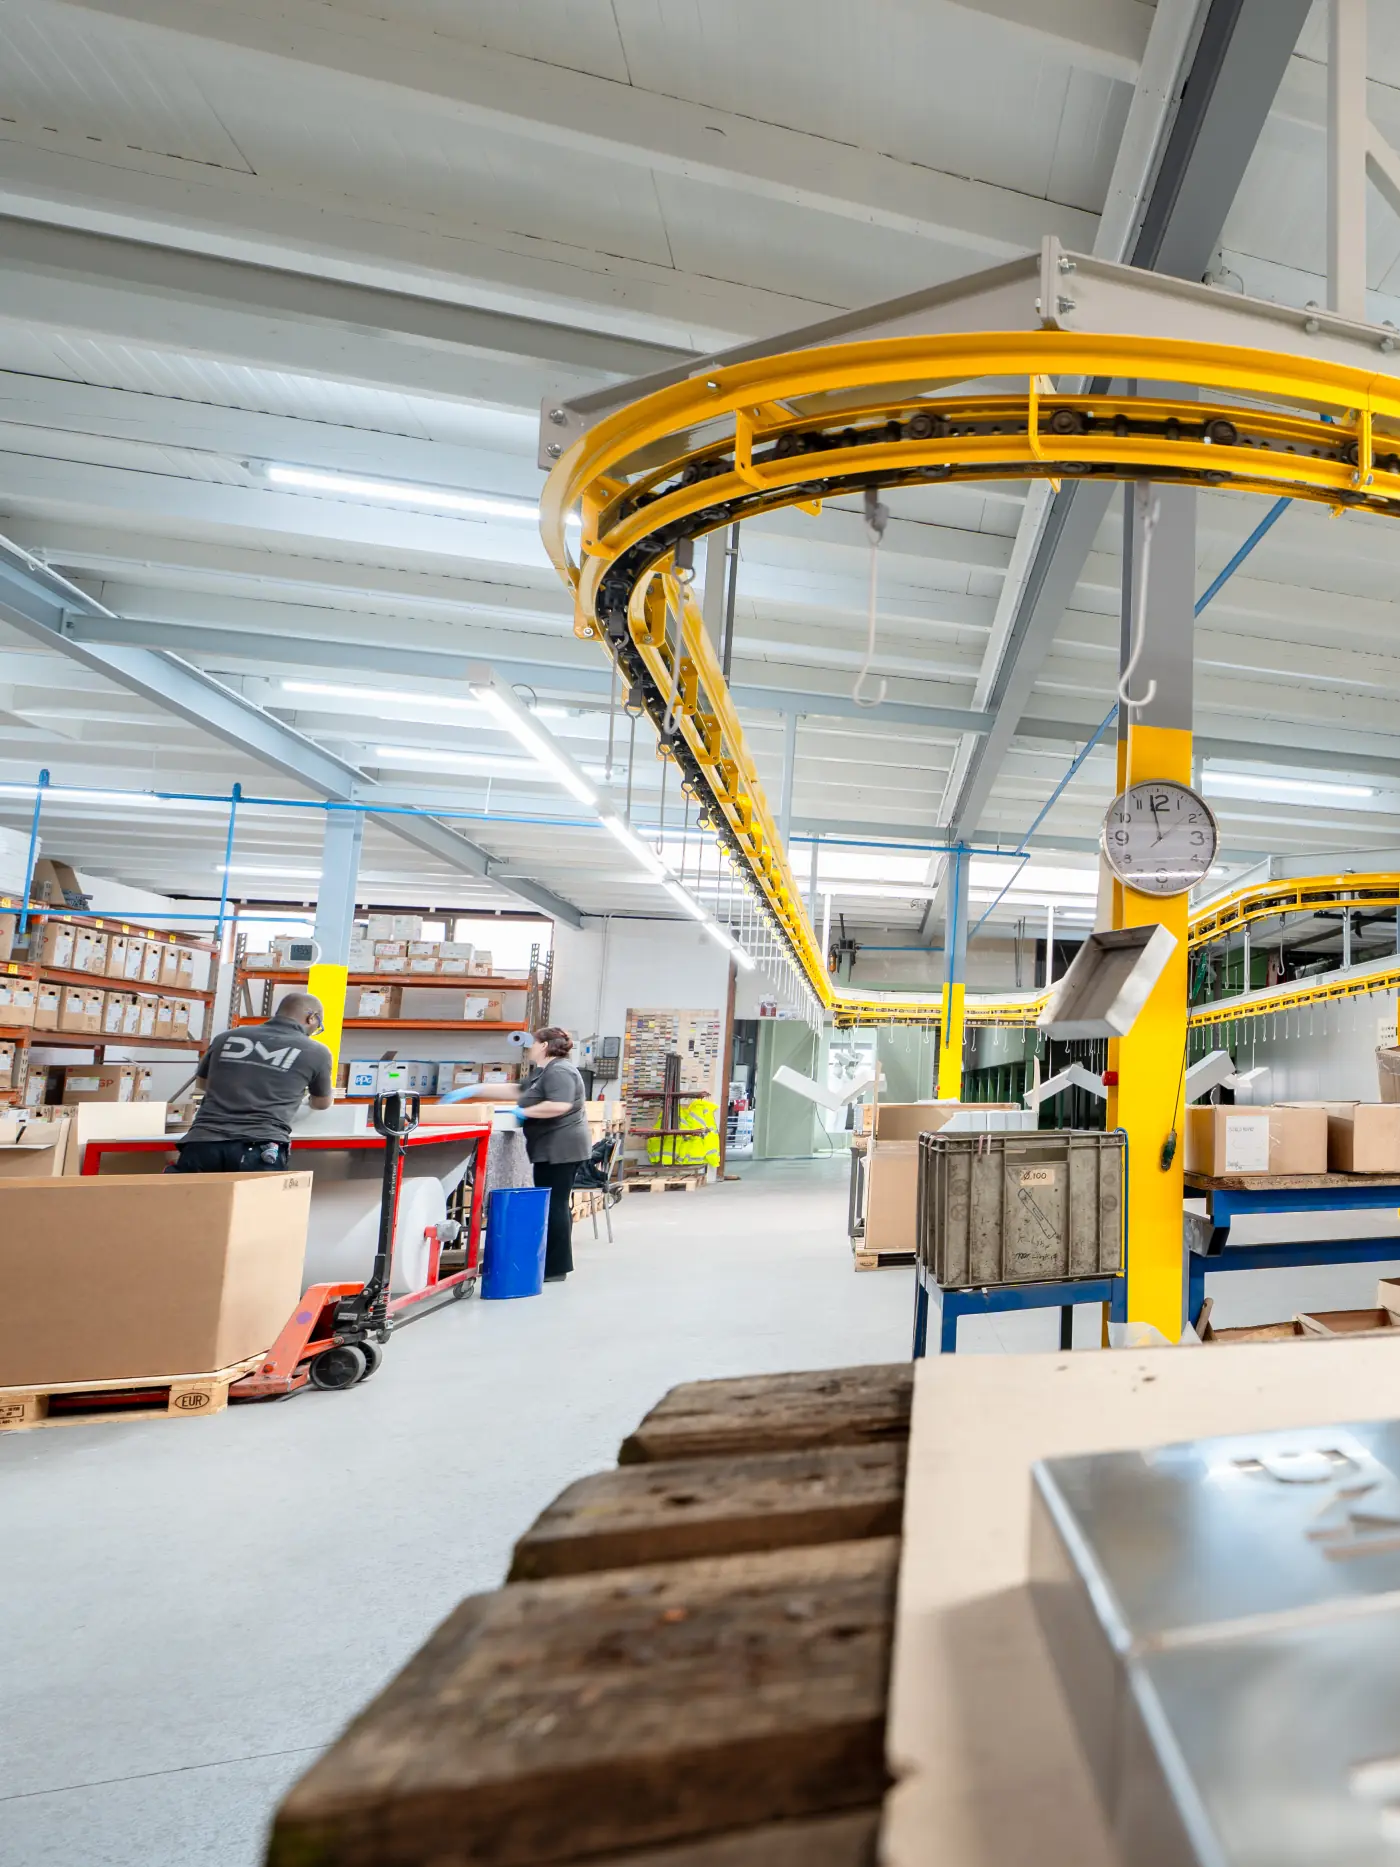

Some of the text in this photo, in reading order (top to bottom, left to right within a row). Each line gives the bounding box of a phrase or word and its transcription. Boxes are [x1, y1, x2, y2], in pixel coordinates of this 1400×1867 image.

[1136, 799, 1143, 811] 11
[1150, 794, 1170, 812] 12
[1119, 812, 1132, 824] 10
[1188, 813, 1198, 824] 2
[1114, 830, 1130, 846] 9
[1189, 830, 1205, 846] 3
[219, 1035, 302, 1070] DMI
[355, 1074, 373, 1086] PPG
[1033, 1172, 1047, 1180] 100
[181, 1393, 204, 1408] EUR
